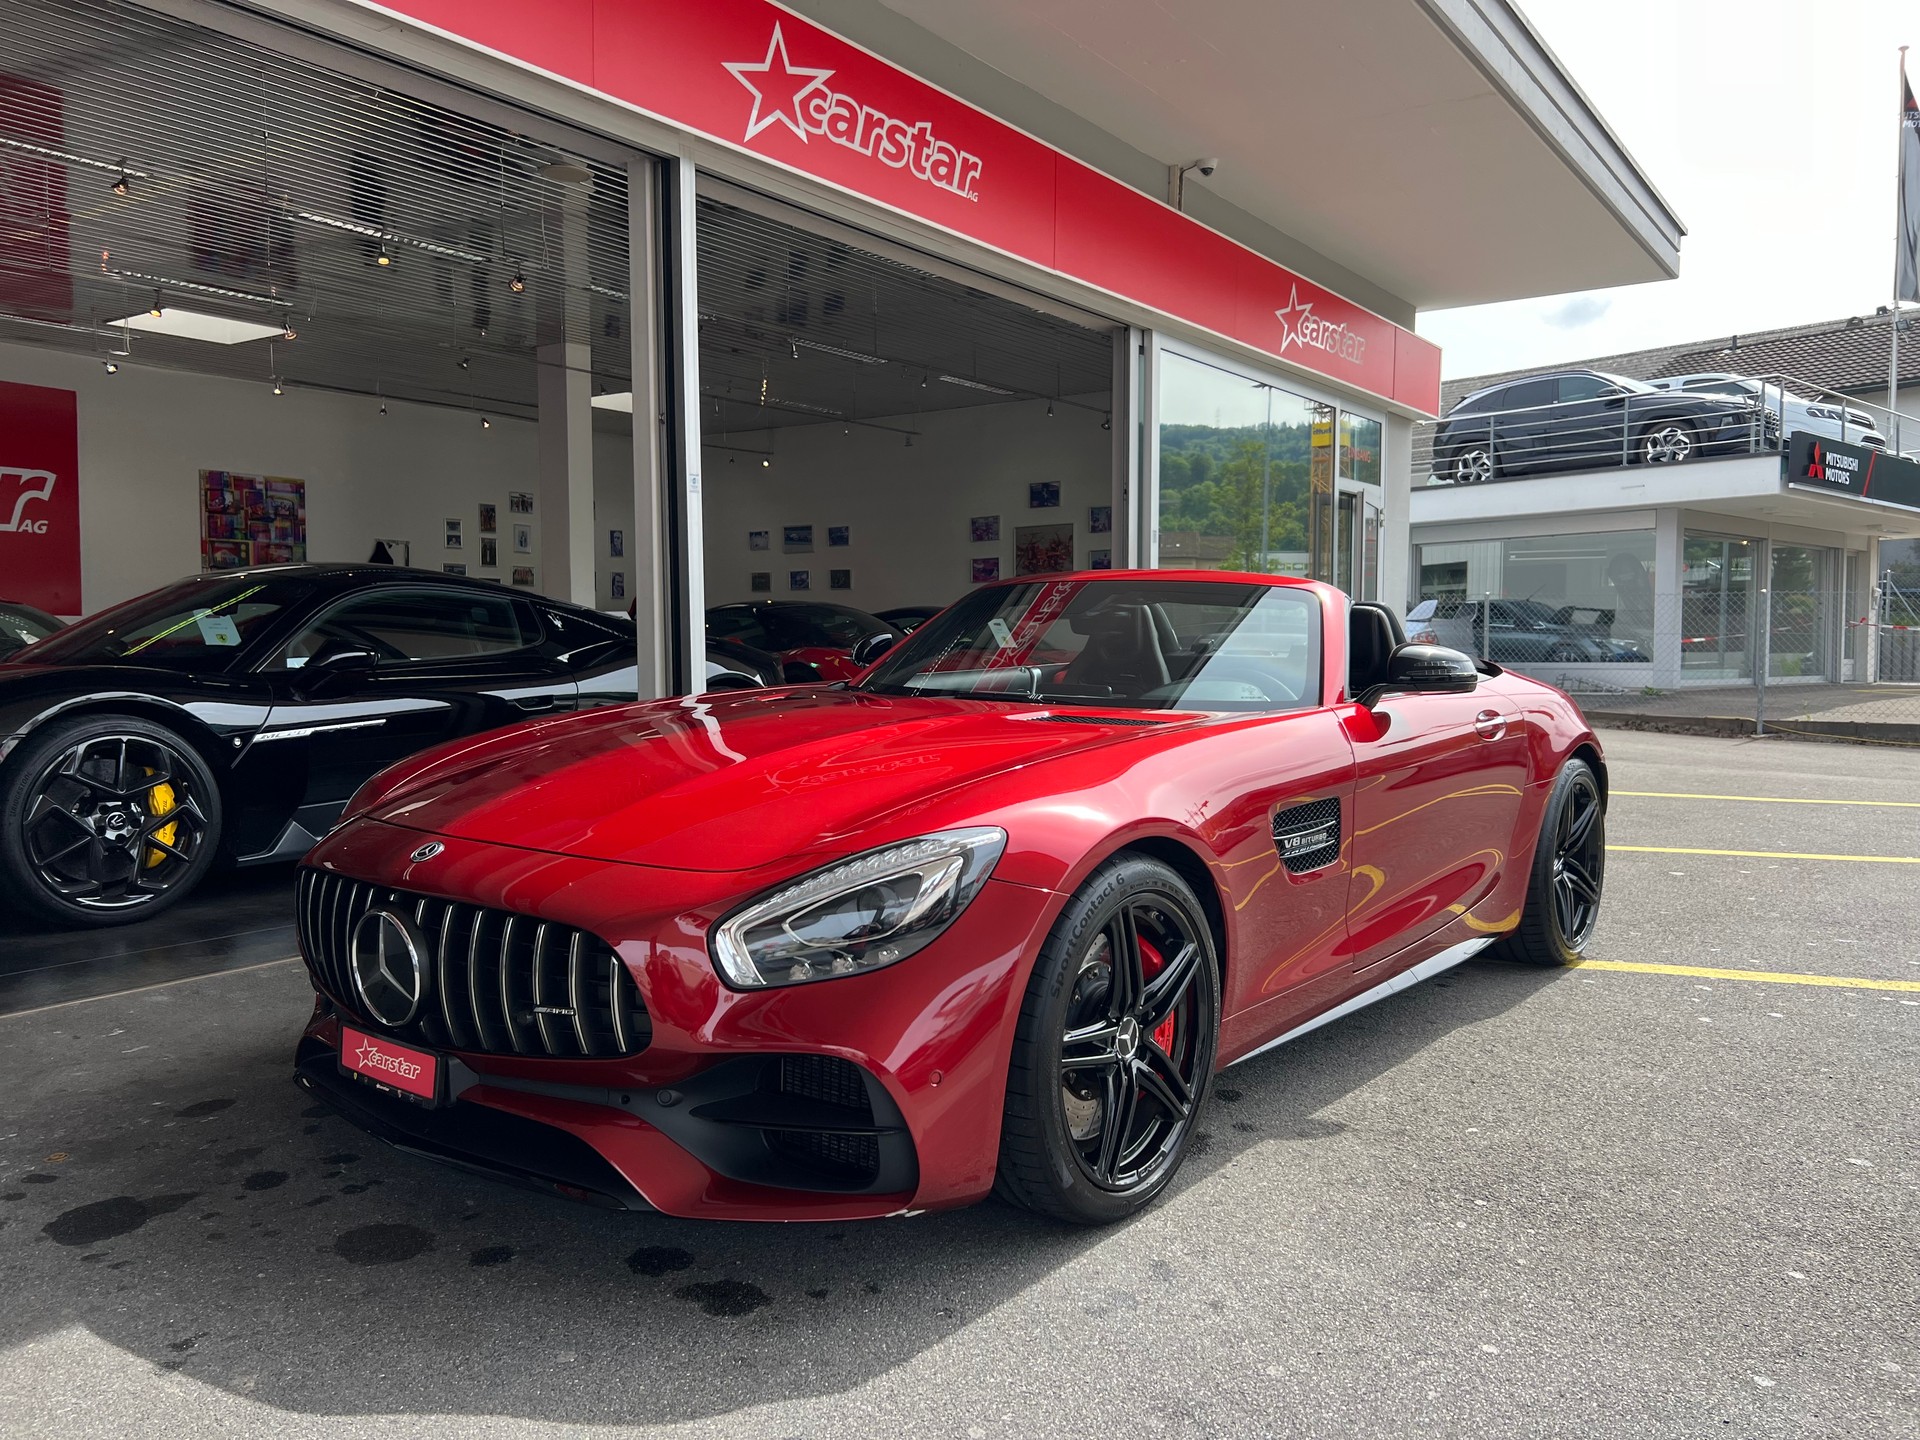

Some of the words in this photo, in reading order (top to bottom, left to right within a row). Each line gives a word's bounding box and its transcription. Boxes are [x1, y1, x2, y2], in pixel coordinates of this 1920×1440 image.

[793, 83, 983, 198] carstar
[966, 190, 979, 203] AG
[1298, 312, 1366, 365] carstar
[1825, 451, 1859, 472] MITSUBISHI
[1825, 467, 1850, 485] MOTORS
[18, 519, 49, 534] AG
[1284, 836, 1301, 849] V8
[1301, 832, 1327, 845] BITURBO
[1115, 873, 1126, 886] 6
[545, 1007, 574, 1015] AMG
[368, 1051, 421, 1080] carstar
